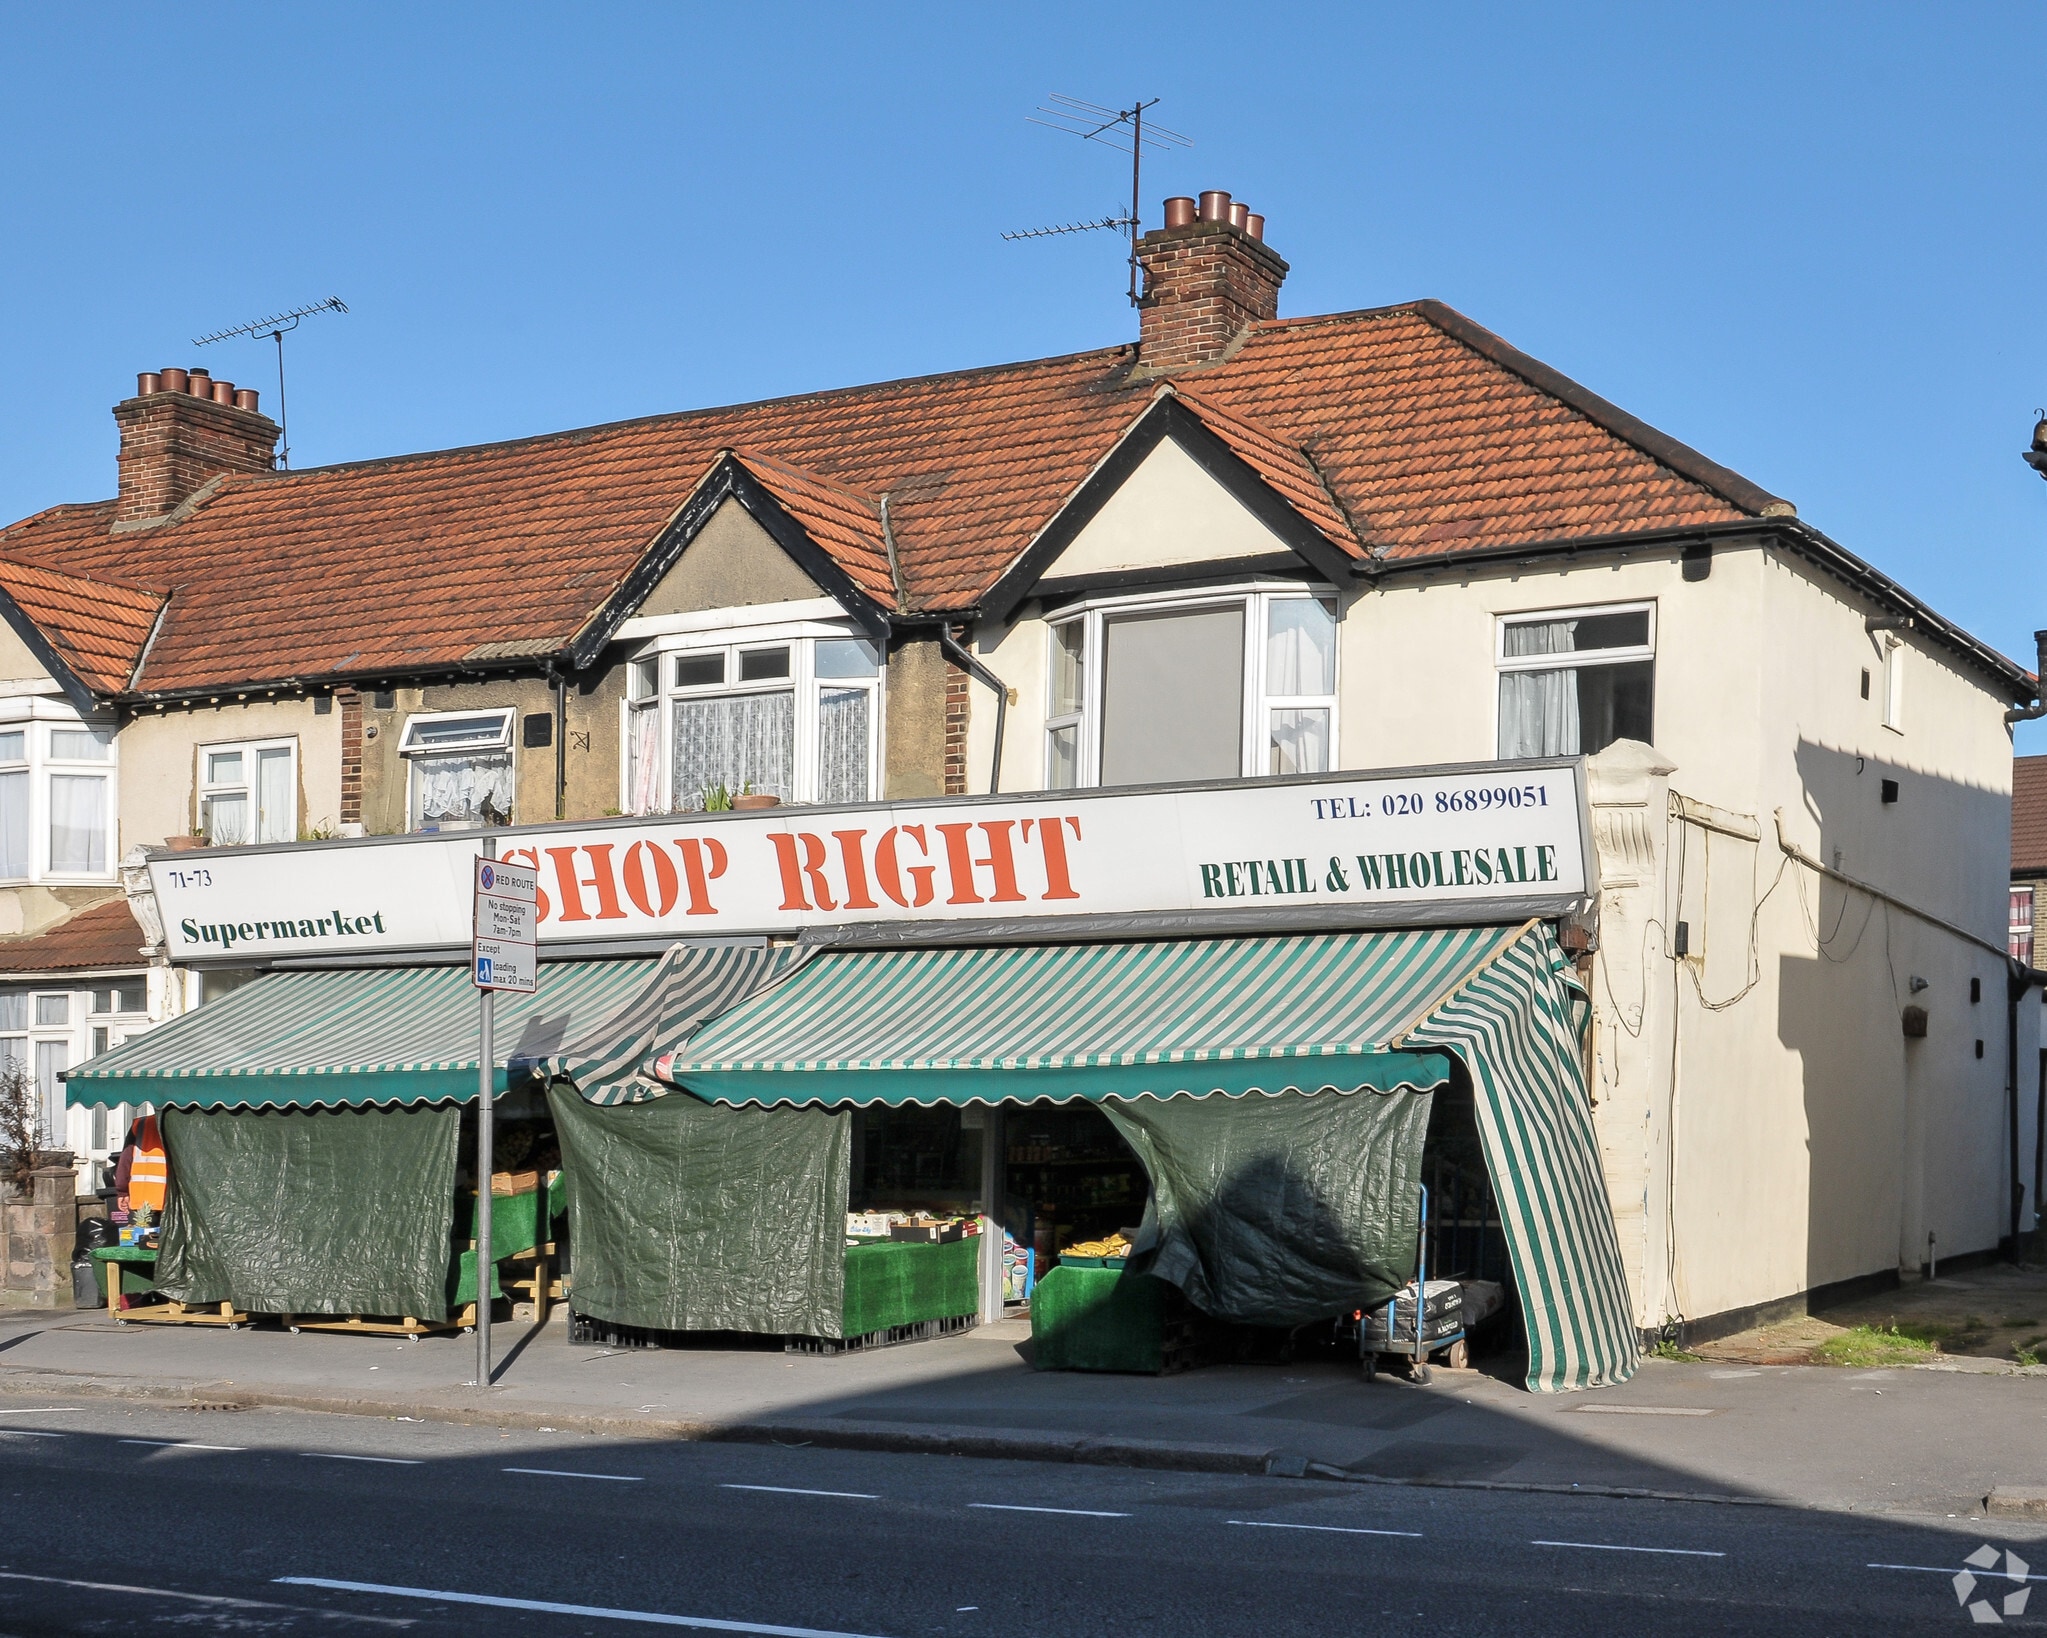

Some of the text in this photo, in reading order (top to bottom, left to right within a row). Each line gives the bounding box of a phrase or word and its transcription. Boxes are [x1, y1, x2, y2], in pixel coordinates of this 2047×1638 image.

[1310, 785, 1549, 820] TEL: 020 86899051
[767, 816, 1081, 912] RIGHT
[1199, 844, 1559, 898] RETAIL & WHOLESALE
[169, 869, 212, 889] 71-73
[495, 874, 535, 891] RED ROUTE
[488, 899, 526, 916] No stopping
[493, 912, 521, 926] Mon-Sat
[181, 910, 388, 949] Supermarket
[492, 925, 522, 938] 7am-7pm
[478, 942, 501, 955] Except
[493, 961, 517, 974] loading
[493, 975, 534, 987] max 20 mins
